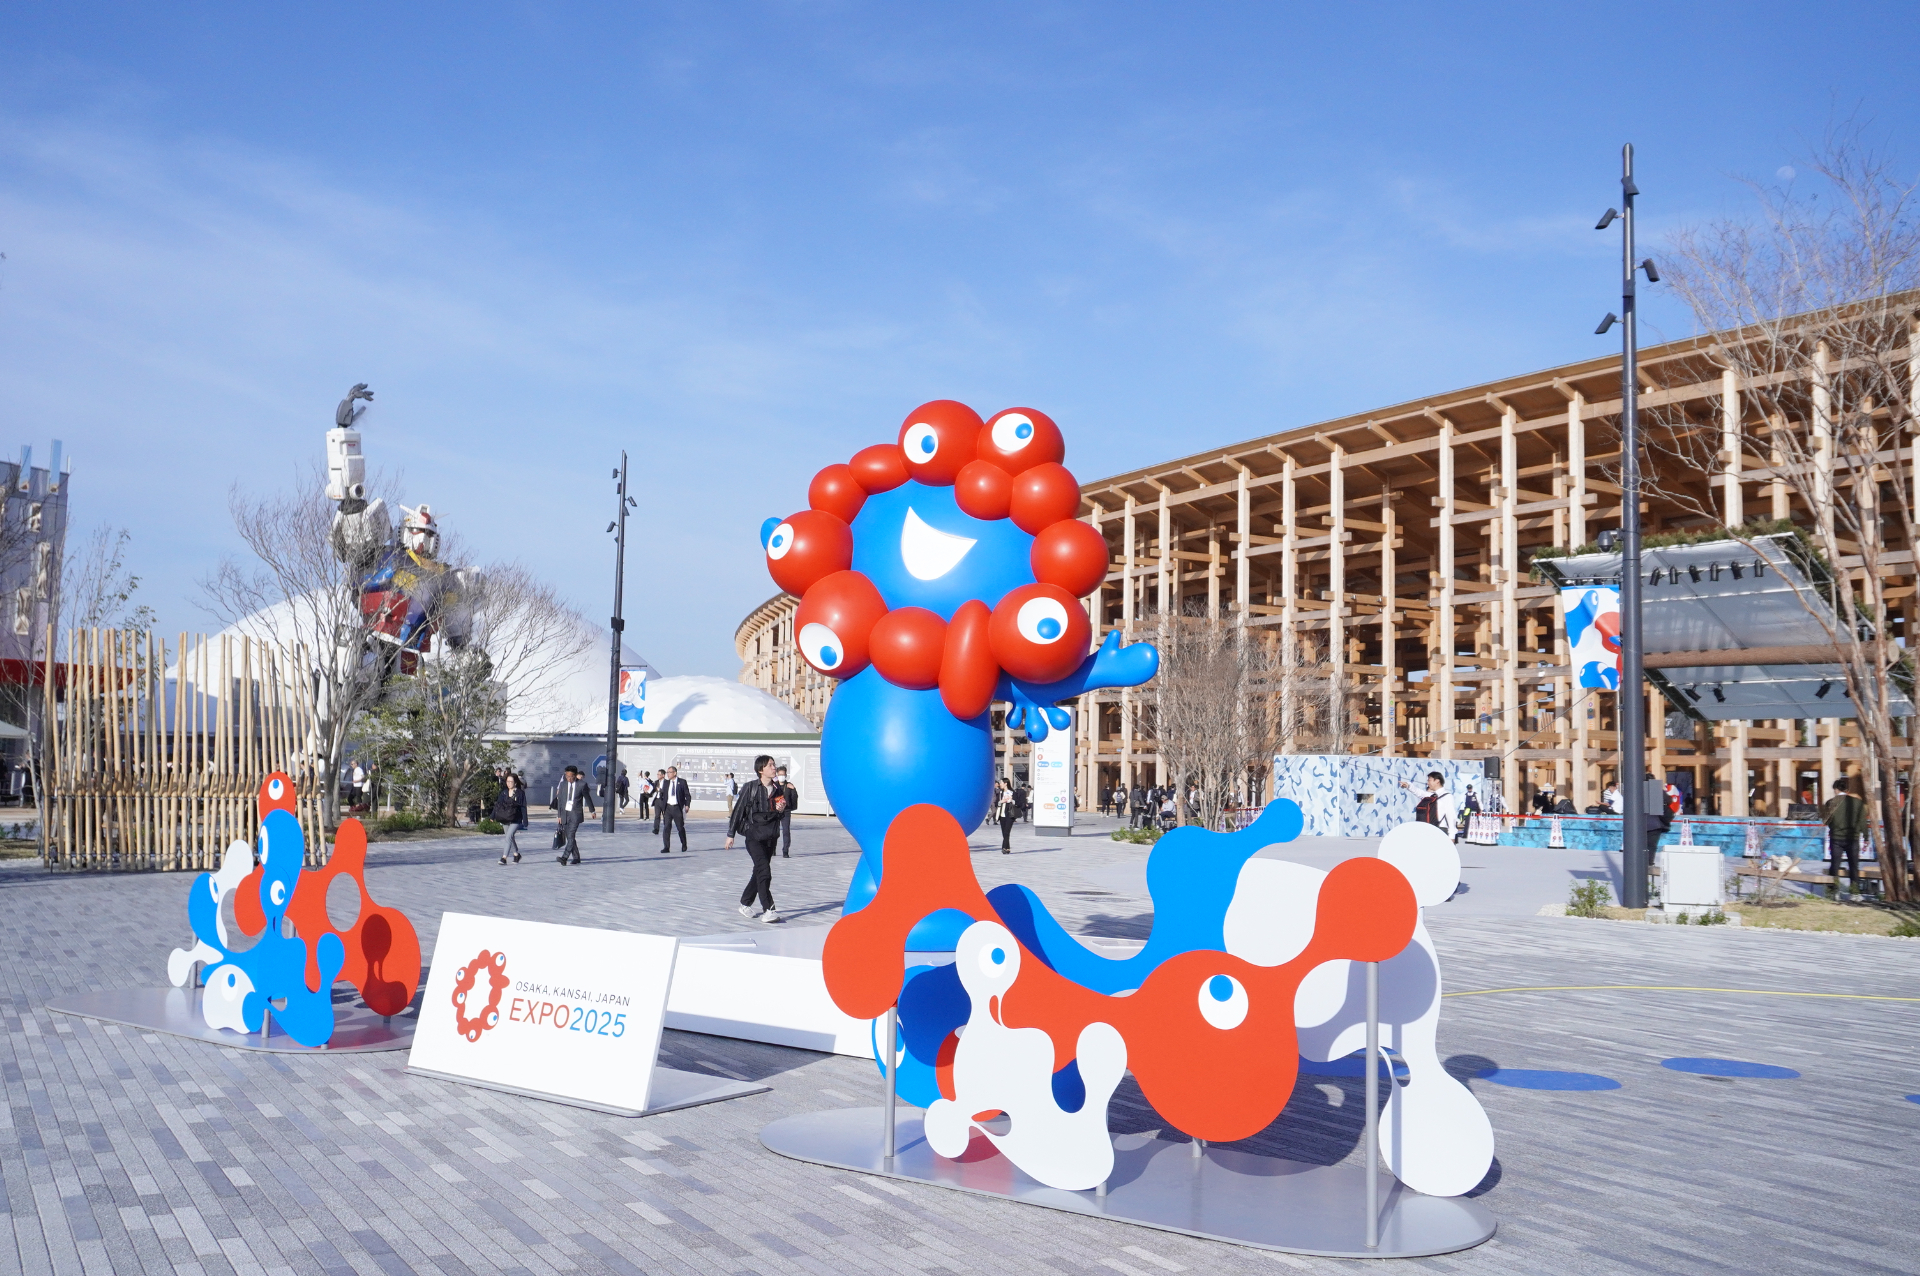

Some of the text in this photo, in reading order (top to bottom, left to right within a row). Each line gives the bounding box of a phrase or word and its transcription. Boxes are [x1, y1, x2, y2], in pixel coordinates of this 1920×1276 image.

[515, 981, 631, 1007] OSAKA, KANSAI, JAPAN
[509, 997, 627, 1038] EXPO2025
